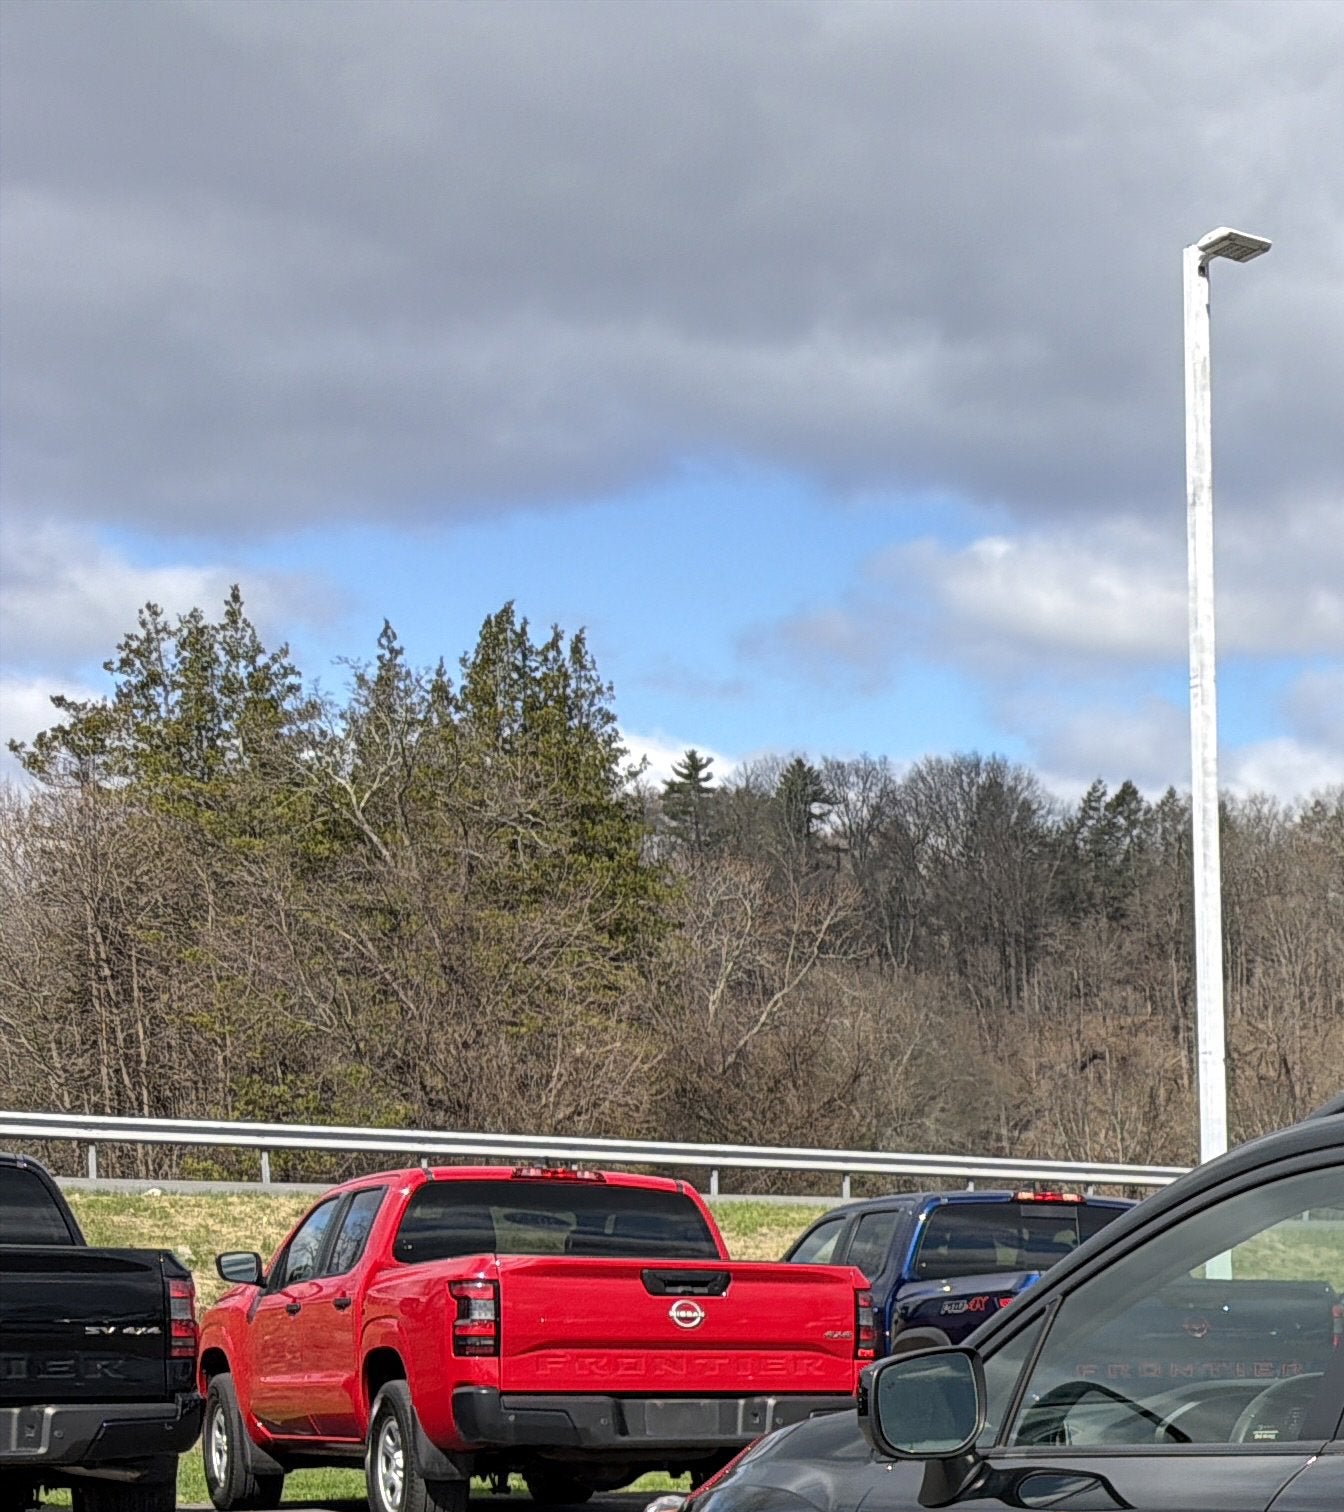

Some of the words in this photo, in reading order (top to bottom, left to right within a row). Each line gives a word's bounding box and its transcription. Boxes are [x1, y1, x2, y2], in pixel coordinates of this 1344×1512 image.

[84, 1326, 115, 1335] SV
[535, 1355, 827, 1377] FRONTIER
[1076, 1360, 1304, 1378] FRONTIER
